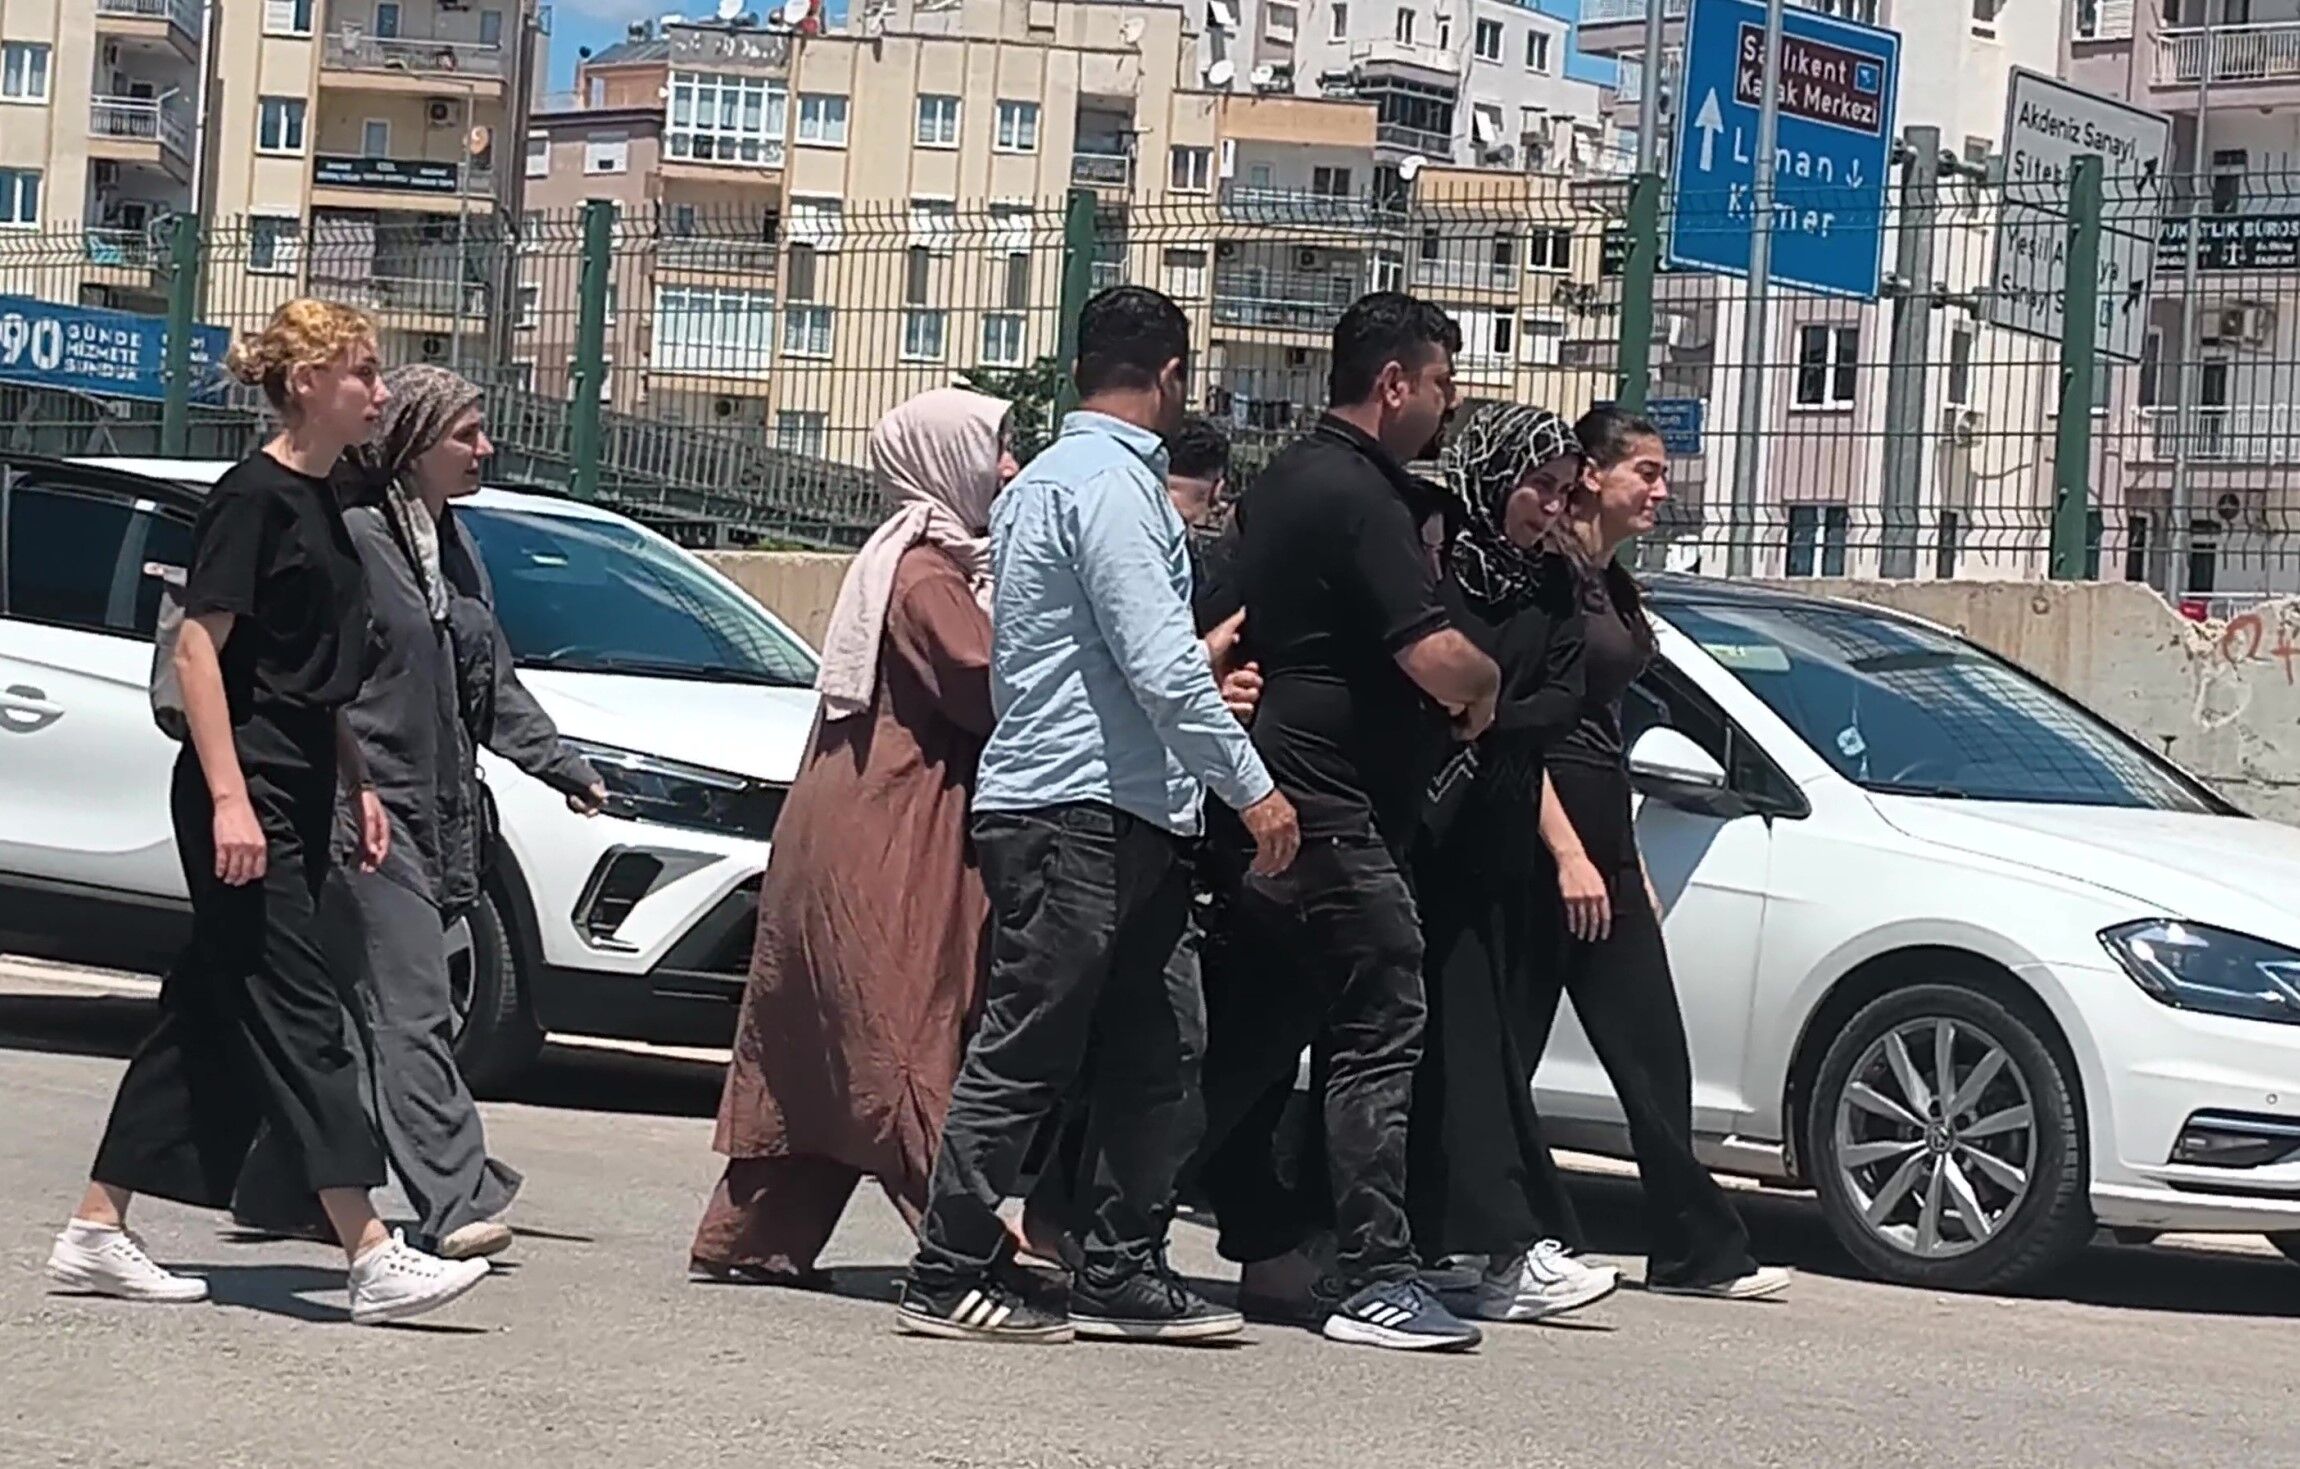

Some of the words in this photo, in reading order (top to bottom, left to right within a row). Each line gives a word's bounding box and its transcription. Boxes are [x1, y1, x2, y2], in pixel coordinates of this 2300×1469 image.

[1743, 35, 1846, 85] Salıkent
[1740, 67, 1798, 107] Kaak
[1803, 83, 1878, 125] Merkezi
[2018, 101, 2080, 144] Akdeniz
[1734, 126, 1833, 183] Lman
[1728, 182, 1835, 238] Kmer
[0, 312, 64, 370] 90
[65, 339, 139, 365] HİZMETE
[67, 322, 142, 349] GÜNDE
